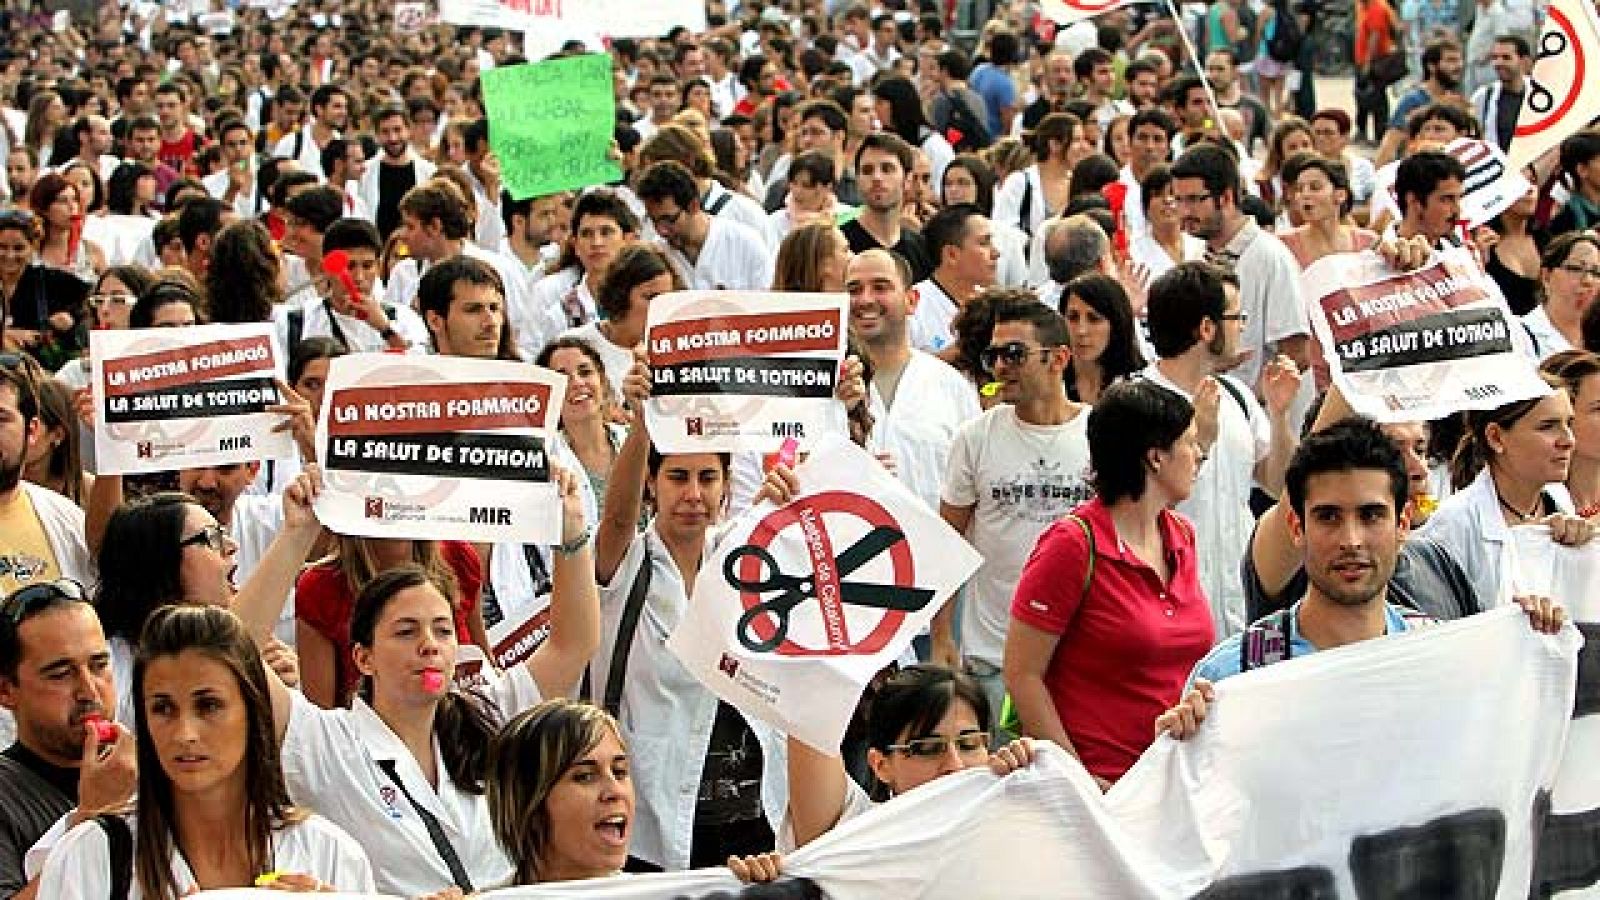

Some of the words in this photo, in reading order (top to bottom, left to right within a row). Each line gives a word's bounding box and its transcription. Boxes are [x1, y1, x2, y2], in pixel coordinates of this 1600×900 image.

[1333, 305, 1358, 326] LA
[652, 338, 672, 354] LA
[676, 329, 741, 351] NOSTRA
[744, 319, 835, 344] FORMACIÓ
[1342, 340, 1366, 359] LA
[1370, 331, 1418, 356] SALUT
[1424, 328, 1443, 349] DE
[1448, 320, 1506, 345] TOTHOM
[107, 371, 126, 387] LA
[129, 359, 189, 384] NOSTRA
[191, 344, 268, 371] FORMACIÓ
[654, 368, 676, 385] LA
[679, 366, 731, 385] SALUT
[734, 367, 756, 385] DE
[759, 368, 831, 387] TOTHOM
[109, 397, 128, 413] LA
[132, 394, 179, 411] SALUT
[182, 392, 204, 409] DE
[207, 387, 276, 407] TOTHOM
[334, 406, 359, 424] LA
[364, 401, 441, 421] NOSTRA
[446, 394, 541, 418] FORMACIÓ
[219, 434, 252, 451] MIR
[772, 421, 806, 438] MIR
[334, 439, 358, 459] LA
[362, 440, 421, 461] SALUT
[427, 445, 453, 464] DE
[459, 448, 543, 469] TOTHOM
[469, 507, 512, 526] MIR
[499, 622, 550, 668] FORMAC
